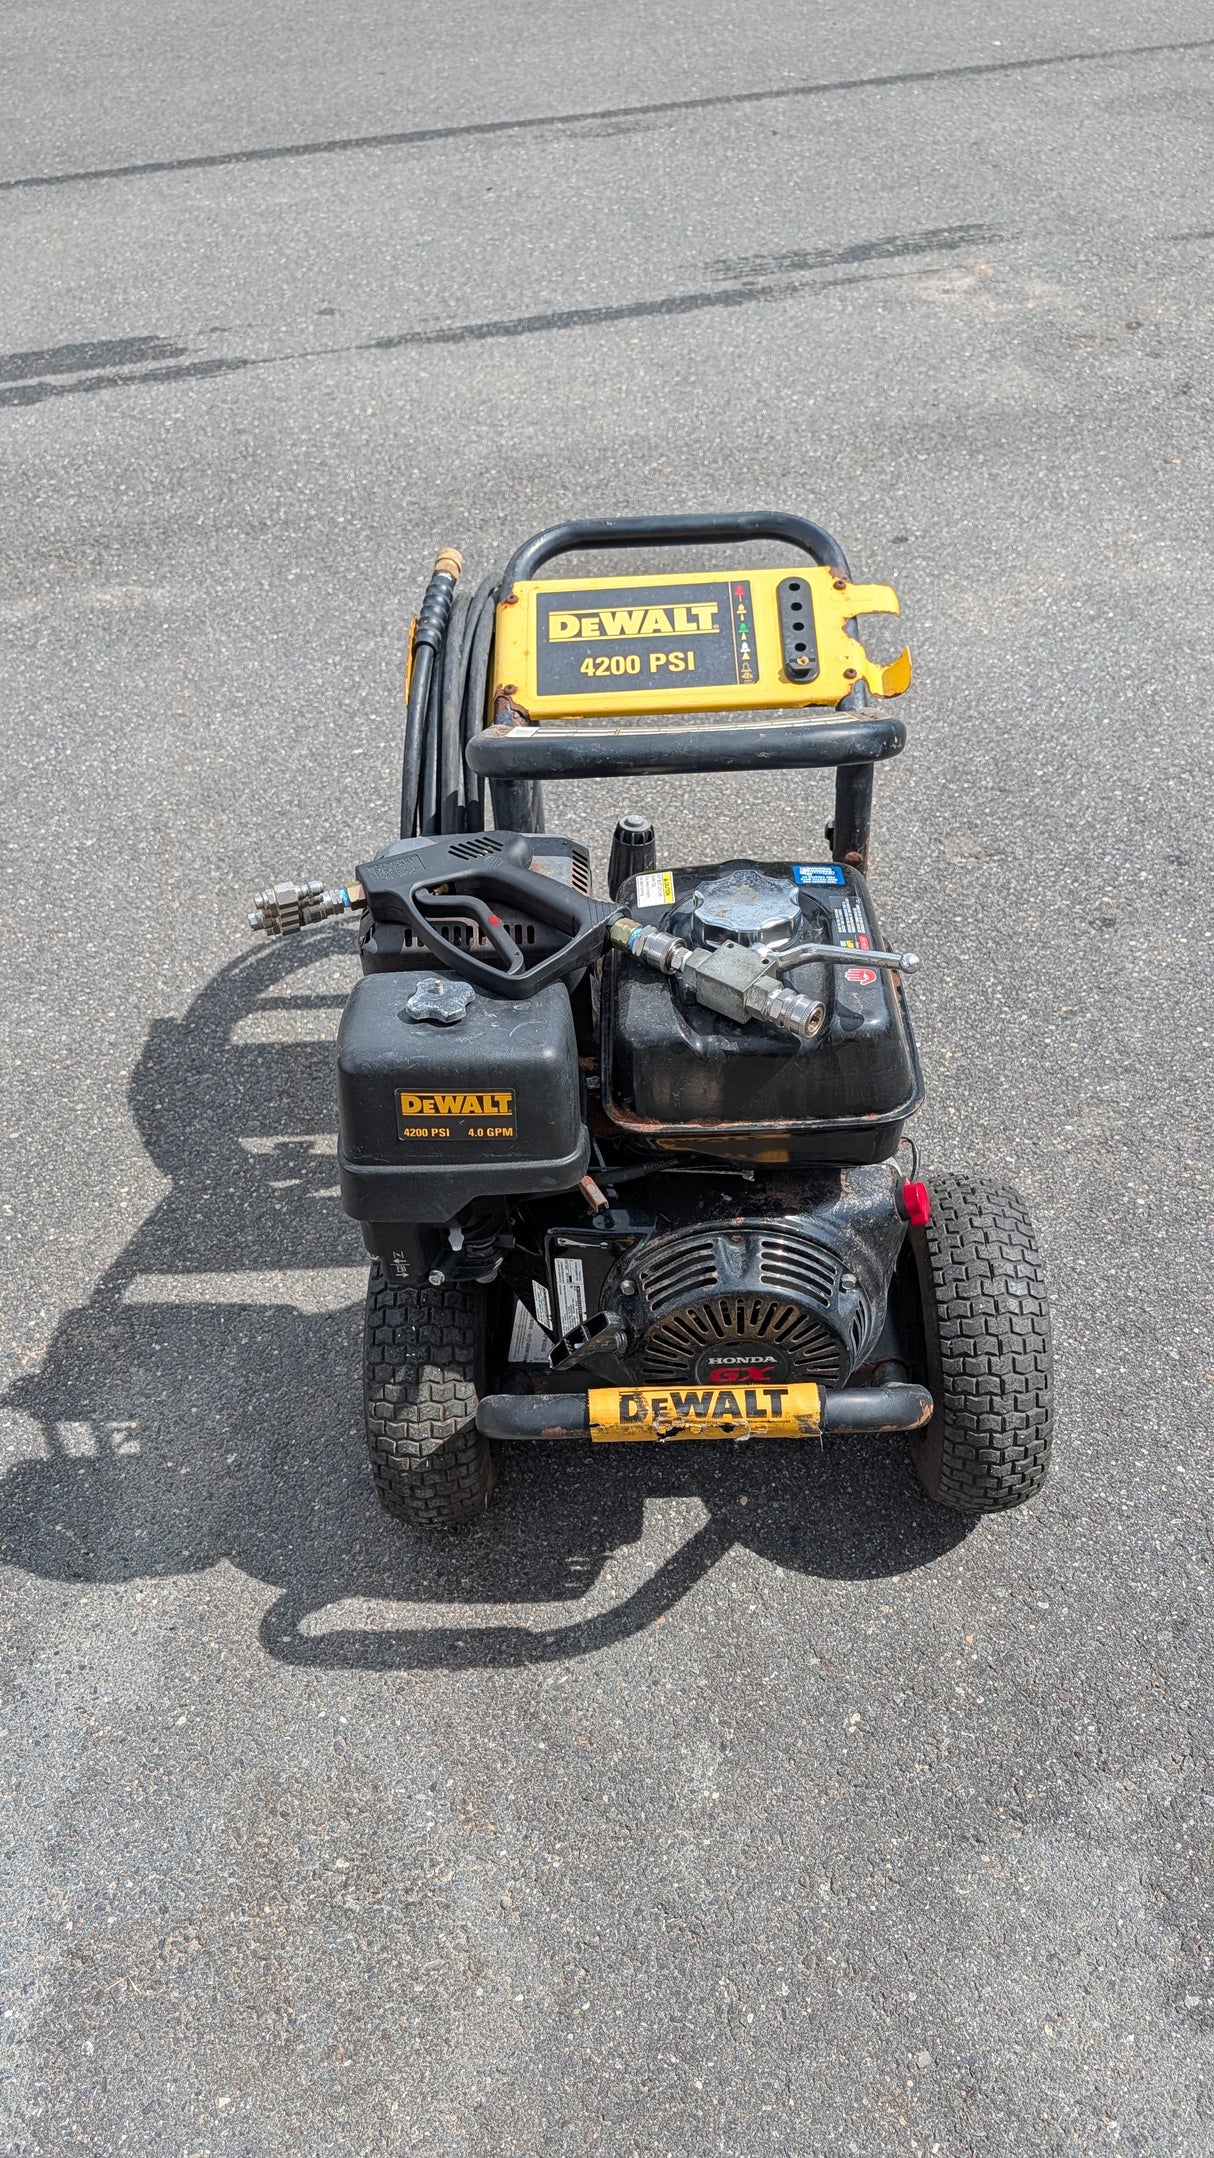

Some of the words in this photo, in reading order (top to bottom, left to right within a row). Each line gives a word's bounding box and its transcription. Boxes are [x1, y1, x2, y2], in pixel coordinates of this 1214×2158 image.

[580, 655, 641, 677] 4200
[649, 651, 695, 673] PSI
[403, 1128, 429, 1137] 4200
[431, 1128, 450, 1137] PSI
[468, 1128, 484, 1137] 4.0
[486, 1127, 513, 1137] GPM
[708, 1355, 778, 1365] HONDA
[709, 1366, 774, 1382] GX
